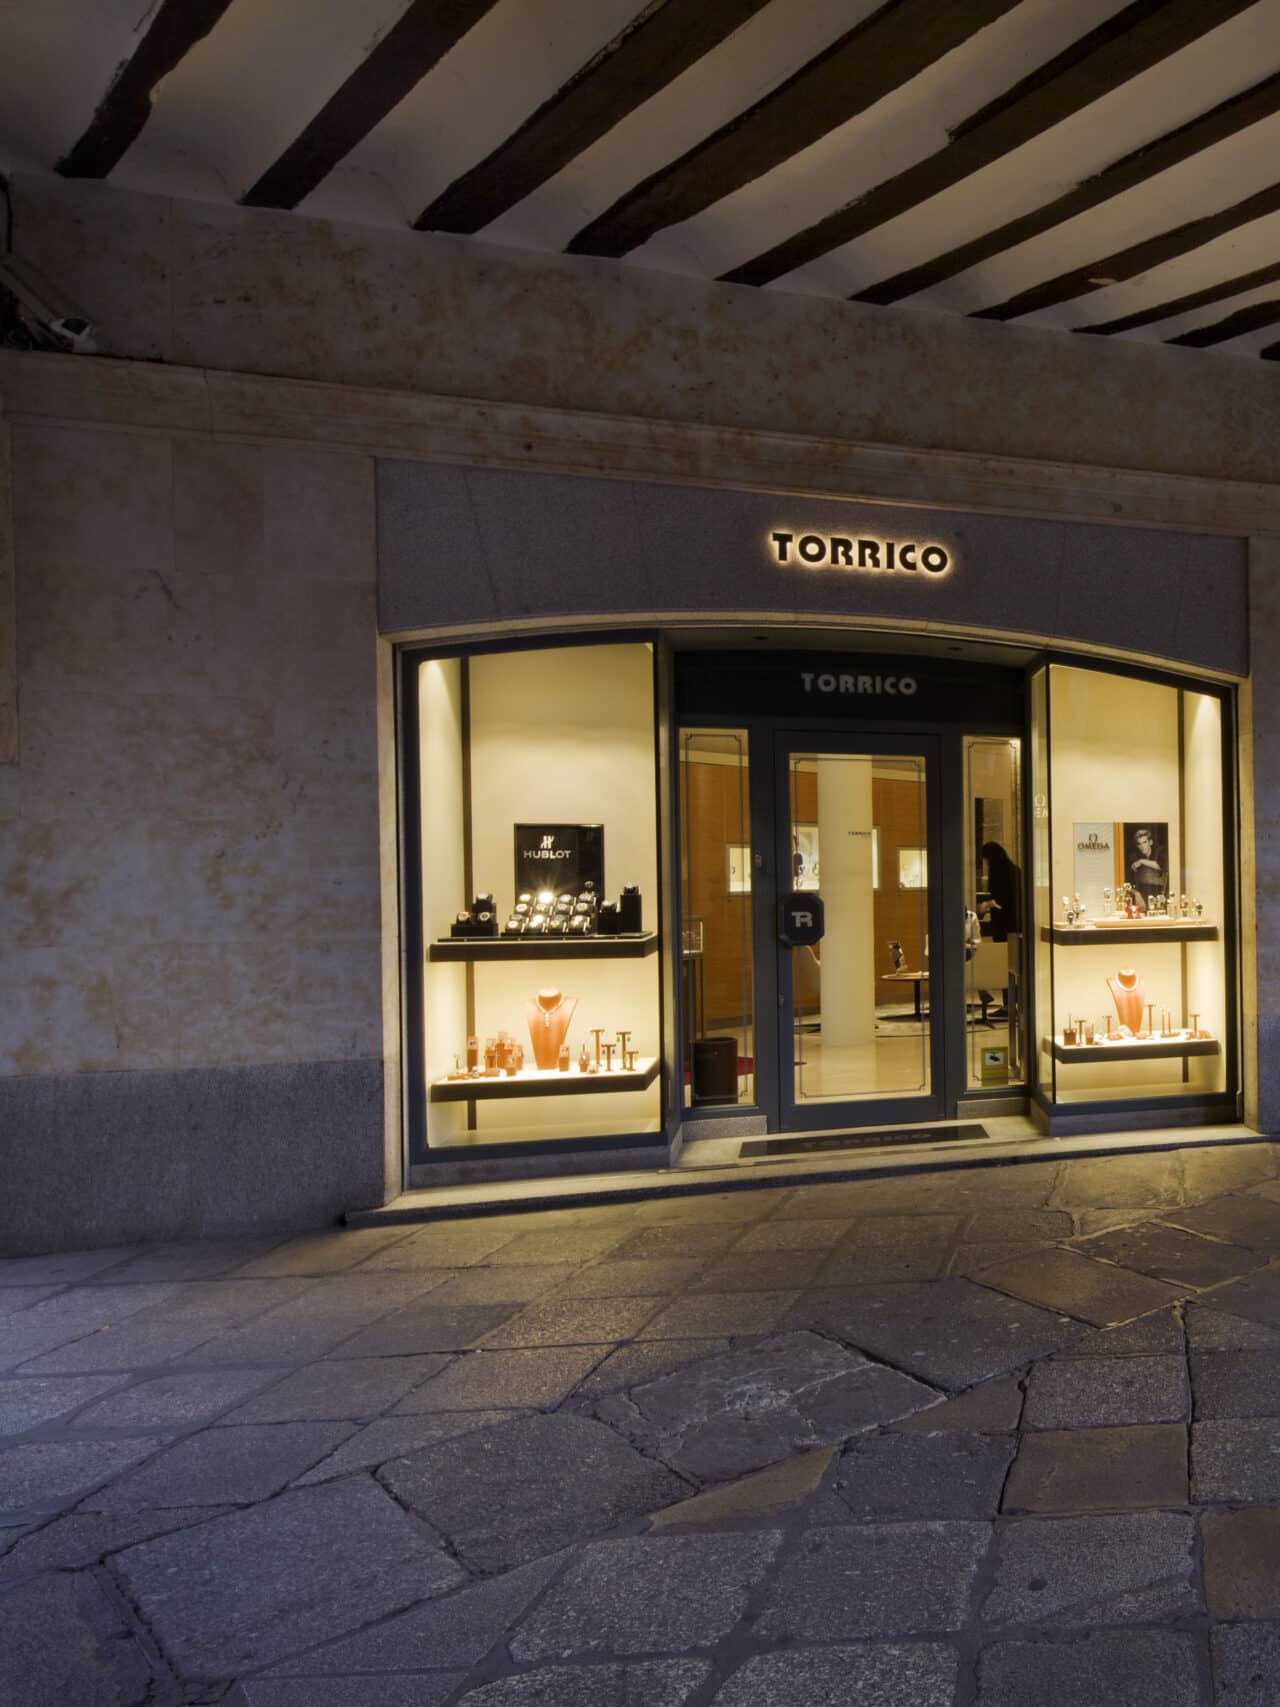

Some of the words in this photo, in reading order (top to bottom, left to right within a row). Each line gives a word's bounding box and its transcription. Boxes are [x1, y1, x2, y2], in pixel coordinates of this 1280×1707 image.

[772, 532, 948, 573] TORRICO
[800, 672, 918, 696] TORRICO
[523, 849, 572, 859] HUBLOT
